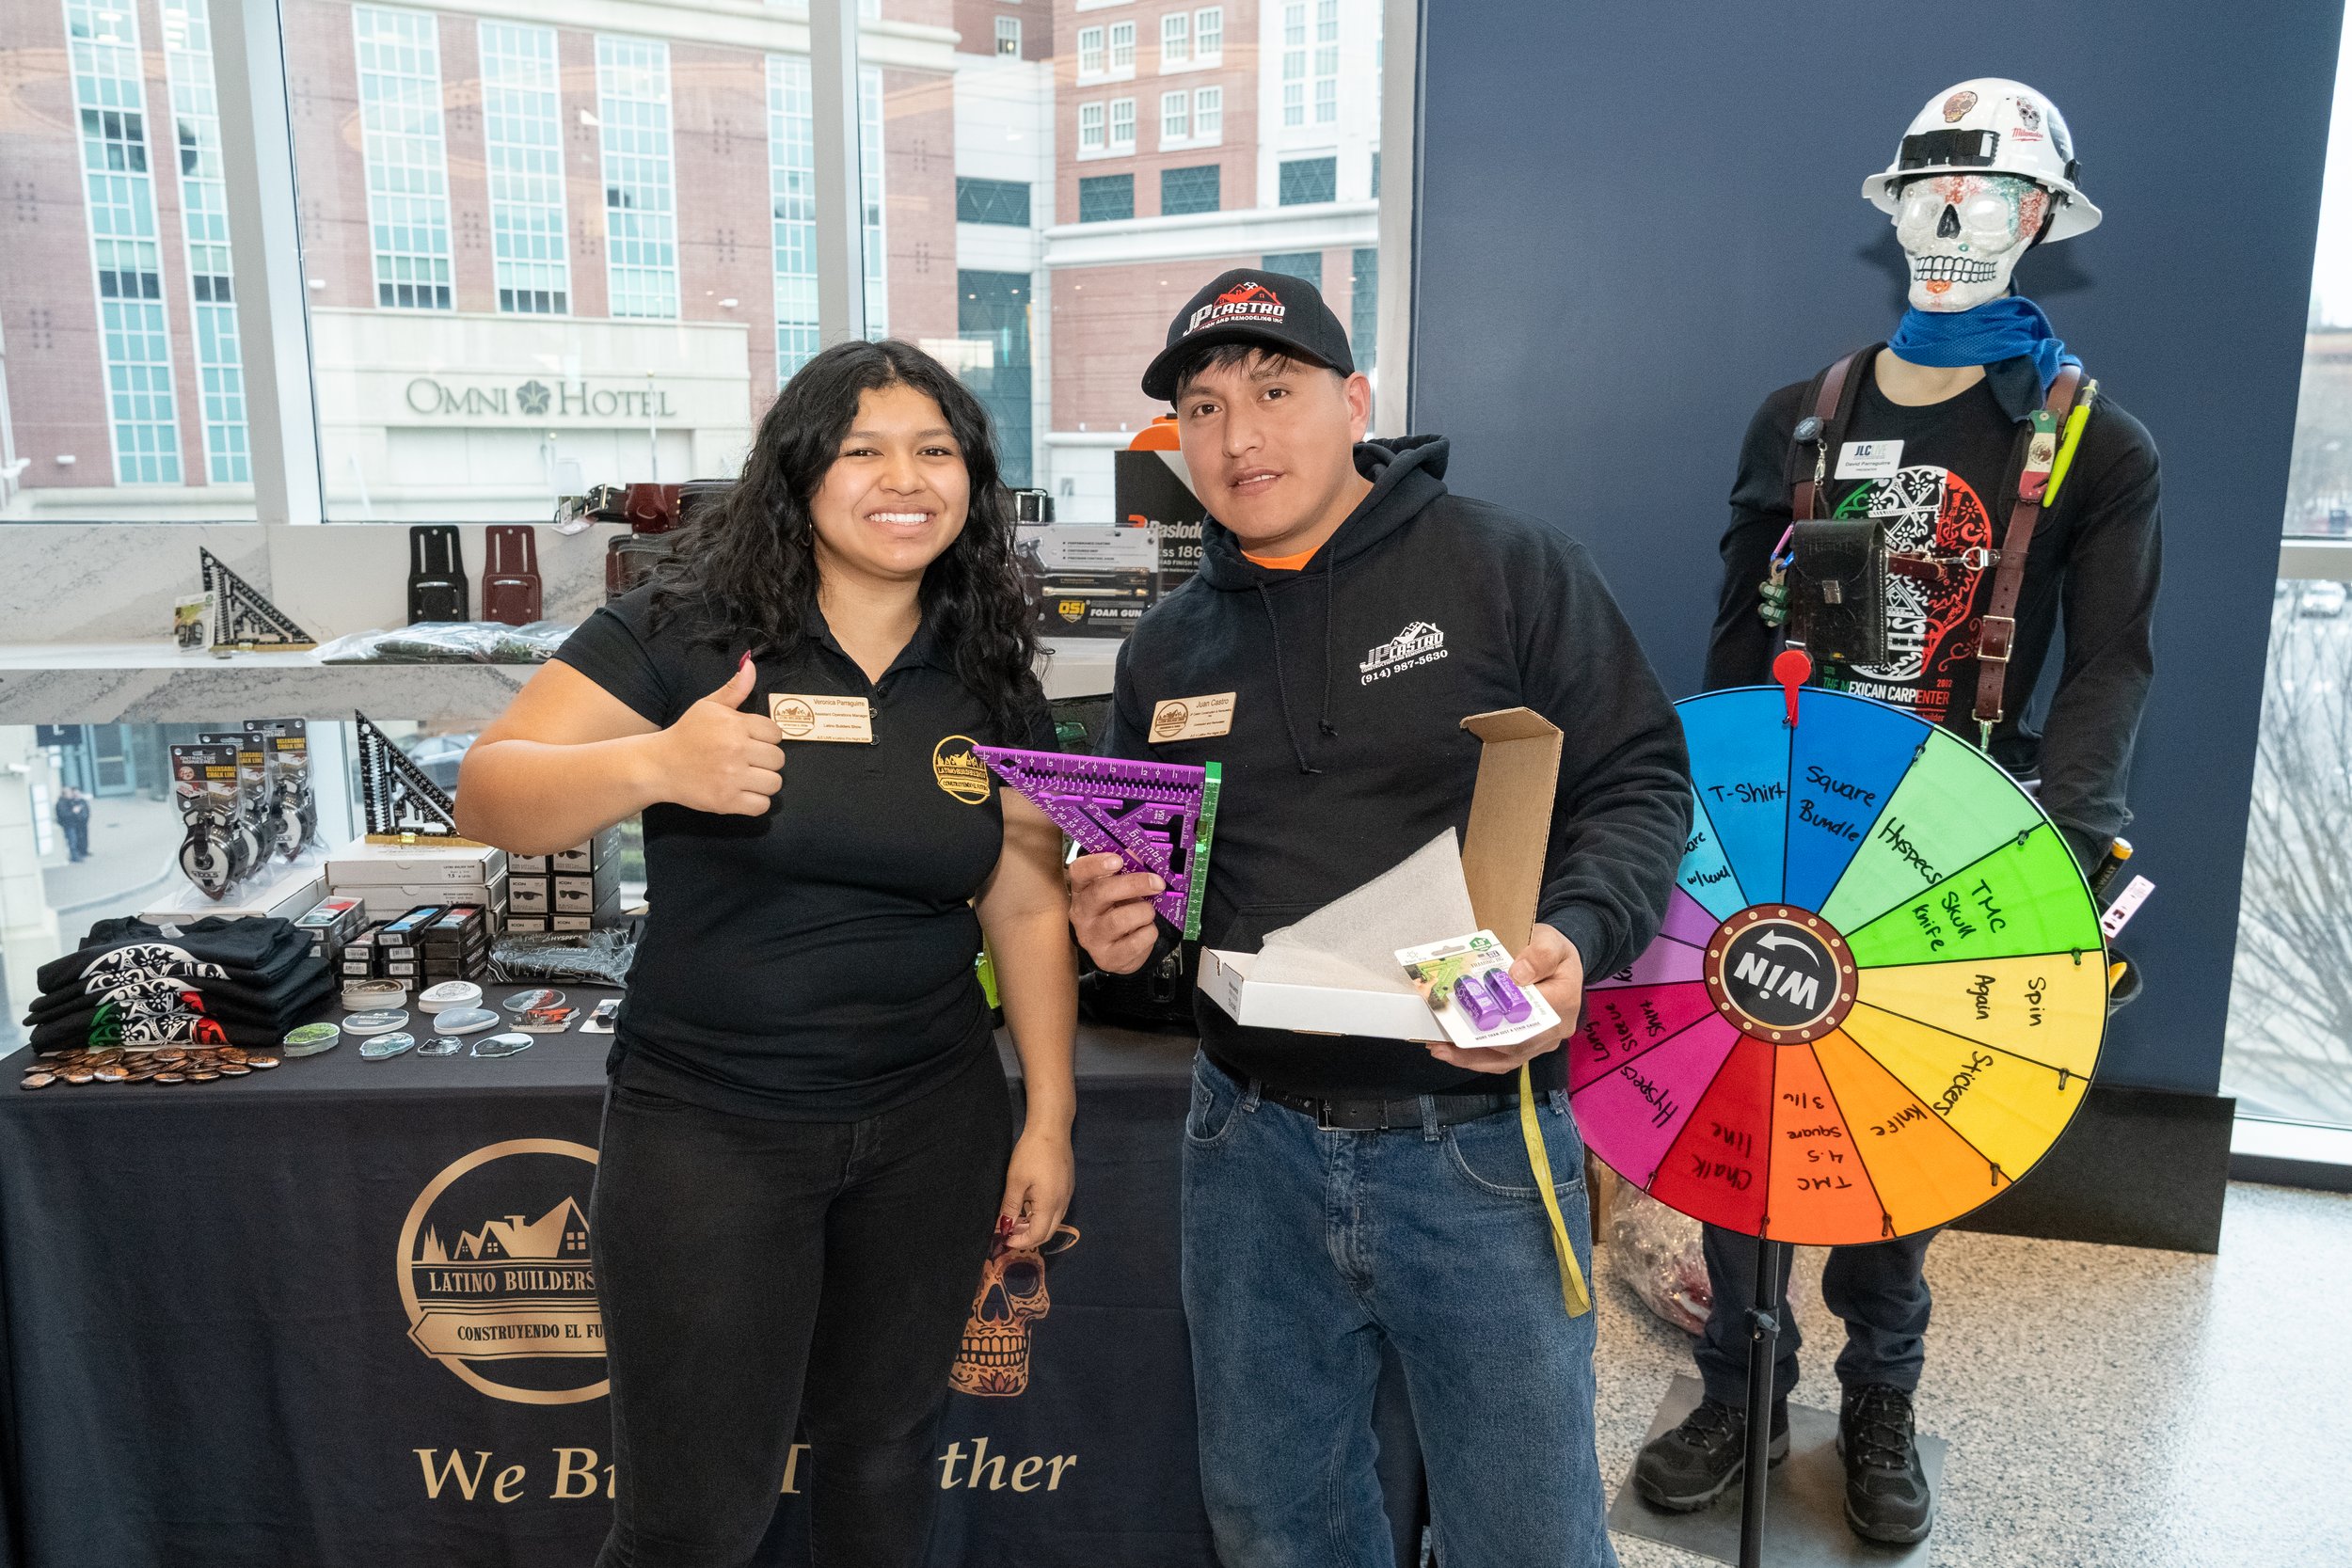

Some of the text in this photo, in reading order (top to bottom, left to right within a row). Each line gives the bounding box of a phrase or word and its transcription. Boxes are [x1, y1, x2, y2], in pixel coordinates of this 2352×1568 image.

[1211, 302, 1285, 319] CASTRO
[406, 377, 676, 417] OMNI HOTEL
[1854, 445, 1871, 456] JLC
[1058, 602, 1086, 614] OSI
[1090, 609, 1118, 617] FOAM
[1389, 632, 1444, 659] CASTRO
[1360, 649, 1448, 686] (914) 987-5630
[1211, 698, 1229, 706] Castro
[1840, 680, 1886, 699] MEXICAN
[1887, 687, 1949, 705] CARPENTER
[1708, 782, 1786, 803] T-Shirt
[1805, 766, 1876, 807] Square
[1157, 810, 1166, 820] USA
[1799, 799, 1860, 842] Bundle
[1942, 891, 1977, 939] Skull
[1972, 879, 2006, 933] TMC
[1966, 974, 1995, 1020] Again
[2025, 976, 2046, 1026] Spin
[1605, 1003, 1638, 1052] Sleeve
[1640, 1000, 1666, 1037] Shirt
[1583, 1021, 1611, 1062] Long
[1933, 1051, 1994, 1116] Stickers
[1808, 1149, 1844, 1164] 4.5
[1797, 1176, 1851, 1190] TMC
[429, 1271, 596, 1292] LATINO BUILDERS
[457, 1324, 560, 1340] CONSTRUYENDO
[564, 1323, 581, 1338] EL
[412, 1448, 525, 1503] We
